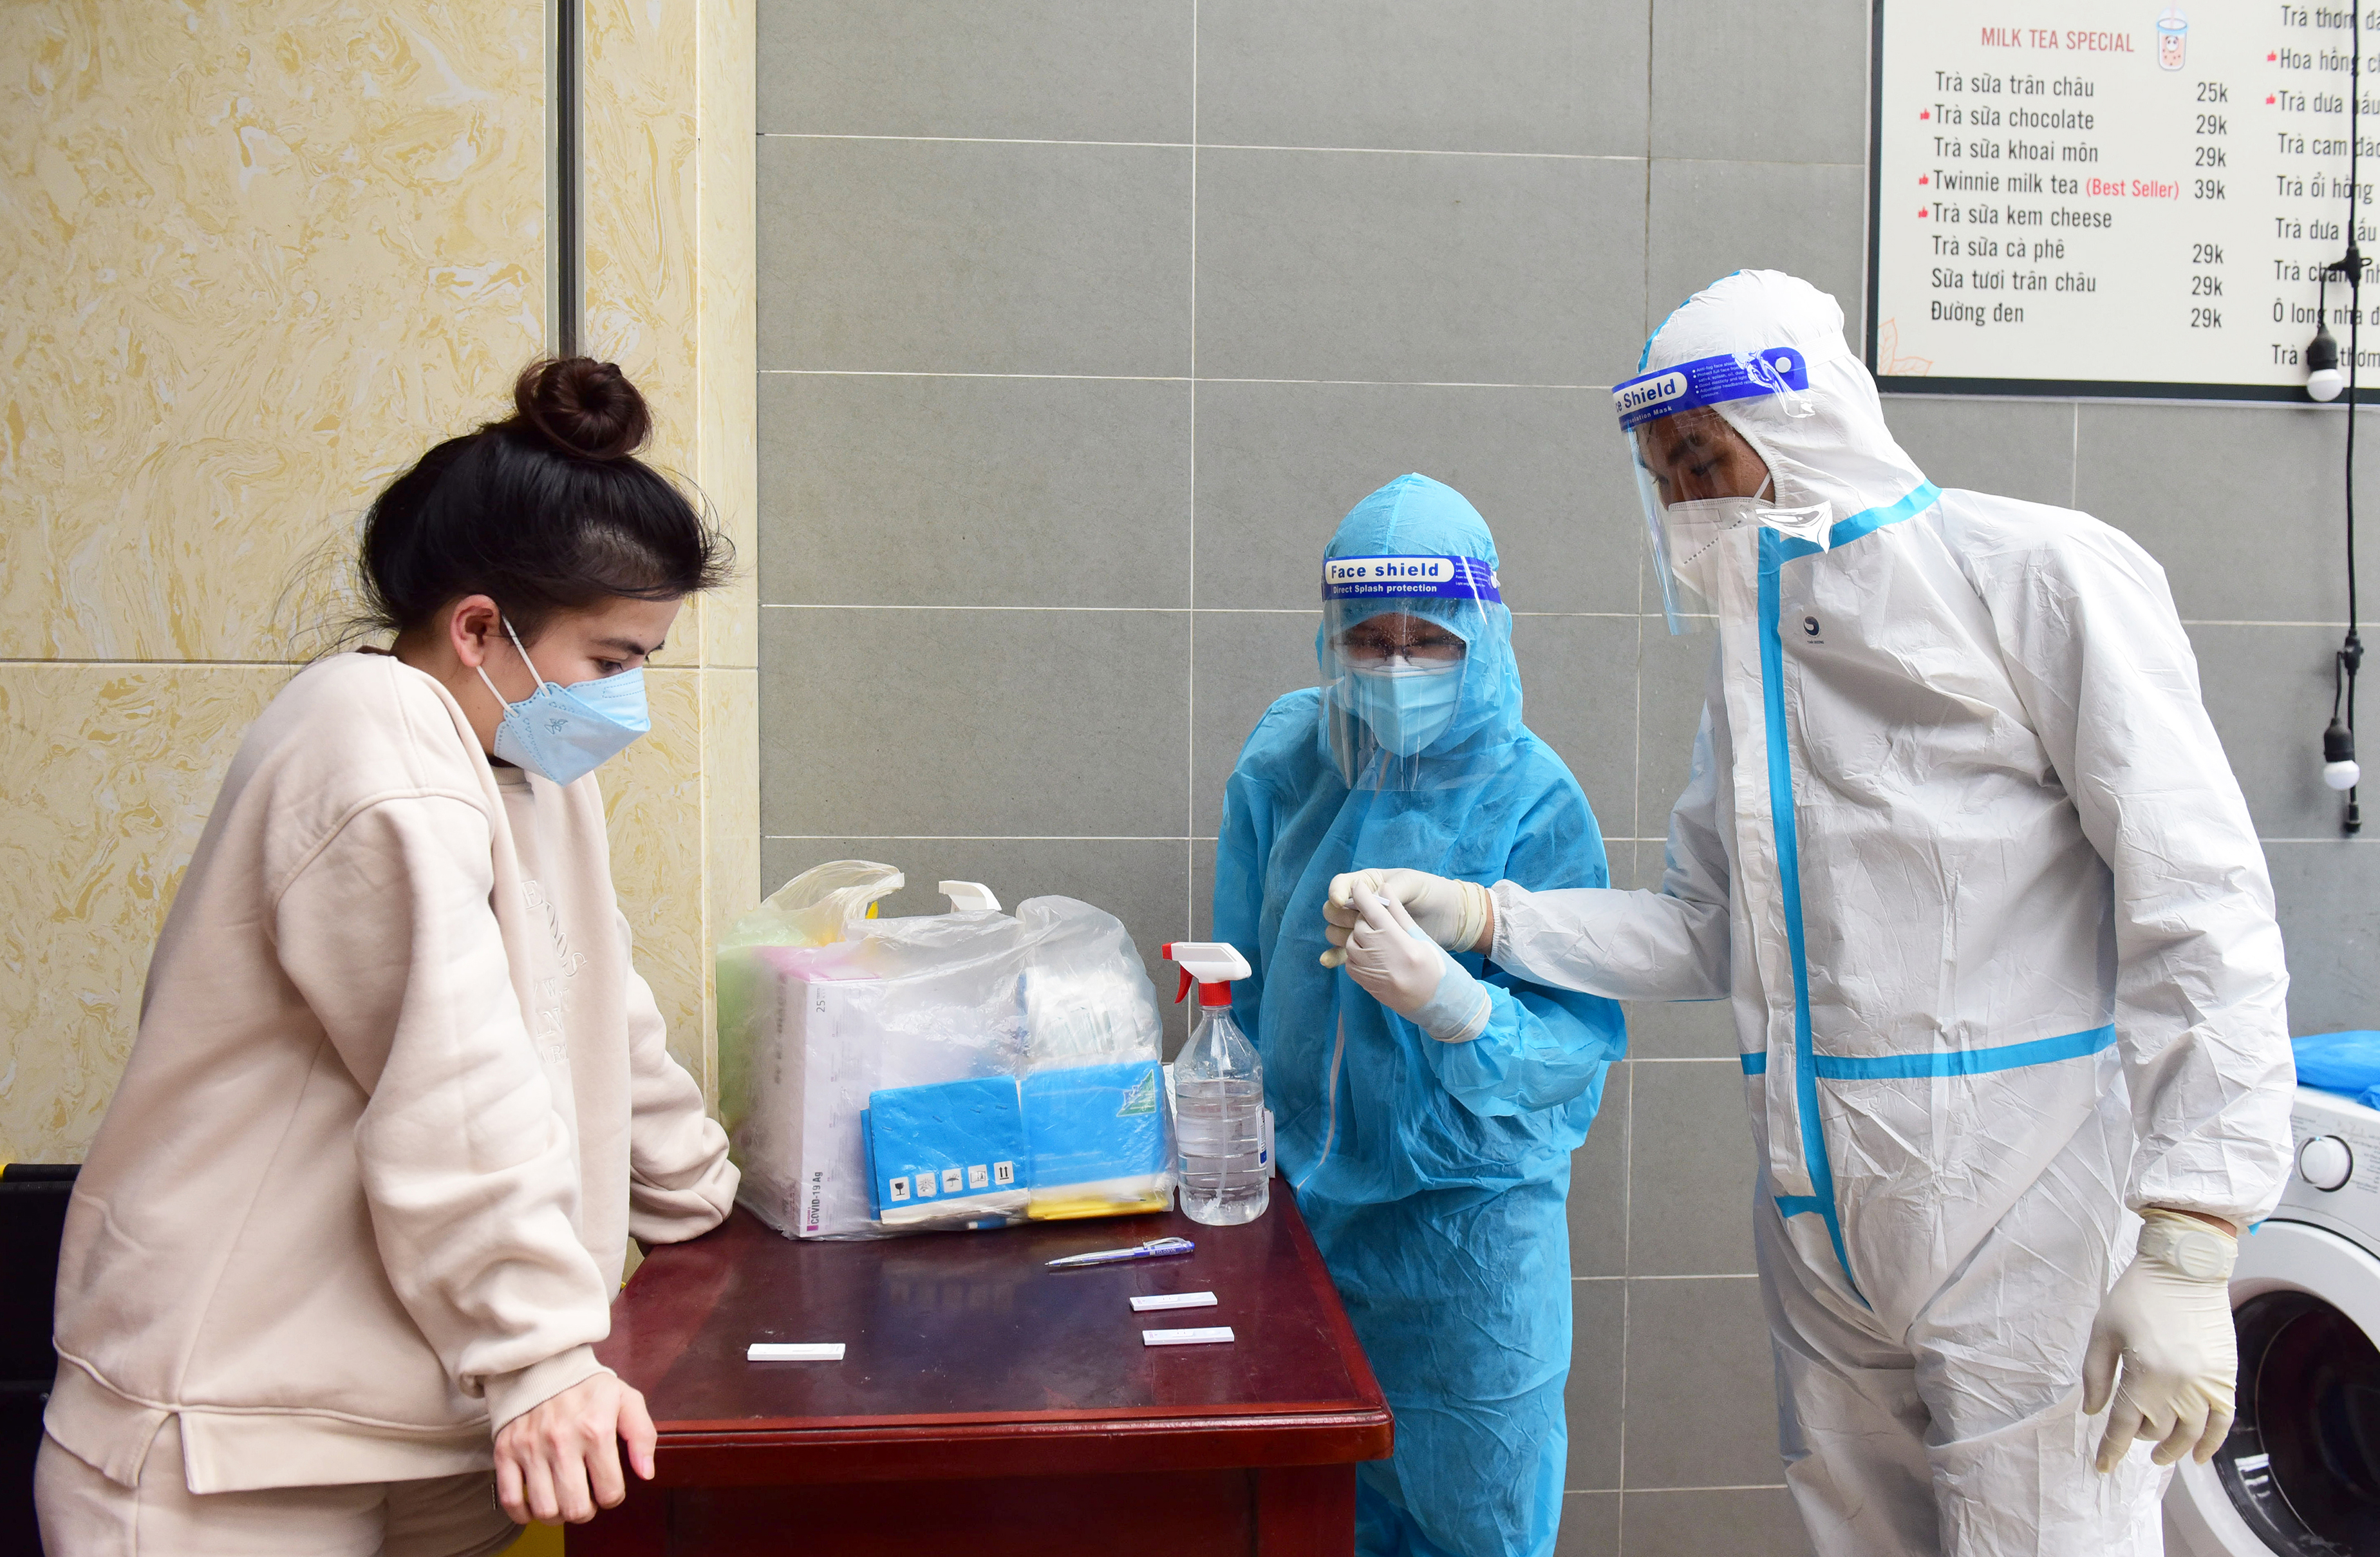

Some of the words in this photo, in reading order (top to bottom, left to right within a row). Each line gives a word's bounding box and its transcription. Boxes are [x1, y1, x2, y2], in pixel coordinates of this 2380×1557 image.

[2282, 5, 2308, 26] Trà
[1982, 27, 2021, 47] MILK
[2029, 29, 2059, 49] TEA
[2066, 31, 2134, 52] SPECIAL
[2280, 48, 2312, 70] Hoa
[1935, 70, 1963, 92] Trà
[1971, 73, 2001, 93] sữa
[2009, 74, 2045, 95] trân
[2053, 76, 2094, 97] châu
[2197, 81, 2228, 102] 25k
[2279, 90, 2305, 111] Trà
[2314, 92, 2343, 113] dưa
[2352, 91, 2380, 115] ấu
[1935, 103, 1962, 125] Trà
[1971, 105, 2000, 126] sữa
[2009, 107, 2094, 130] chocolate
[2196, 113, 2227, 135] 29k
[1934, 136, 1962, 158] Trà
[1970, 138, 2000, 159] sữa
[2009, 139, 2054, 161] khoai
[2063, 142, 2098, 162] môn
[2278, 132, 2304, 154] Trà
[2312, 139, 2348, 156] cam
[2195, 146, 2226, 167] 29k
[1933, 169, 2000, 192] Twinnie
[2007, 173, 2043, 193] milk
[2050, 175, 2078, 194] tea
[2086, 178, 2126, 197] (Best
[2132, 179, 2179, 200] Seller)
[2194, 178, 2225, 200] 39k
[2277, 175, 2303, 196] Trà
[2311, 171, 2325, 198] ổi
[1933, 202, 1960, 223] Trà
[1969, 203, 1999, 225] sữa
[2007, 205, 2043, 226] kem
[2050, 206, 2112, 228] cheese
[2275, 217, 2301, 238] Trà
[2310, 219, 2339, 240] dưa
[2349, 217, 2377, 241] ấu
[1932, 235, 1960, 256] Trà
[1968, 236, 1998, 257] sữa
[2006, 238, 2026, 258] cà
[2034, 238, 2065, 263] phê
[2193, 243, 2224, 264] 29k
[1931, 267, 1963, 288] Sữa
[1972, 269, 2004, 290] tươi
[2012, 270, 2048, 290] trân
[2055, 272, 2096, 292] châu
[2274, 260, 2300, 281] Trà
[2191, 275, 2223, 296] 29k
[1931, 300, 1986, 327] Đường
[1993, 302, 2024, 323] đen
[2191, 307, 2222, 328] 29k
[2273, 297, 2283, 323] Ô
[2272, 344, 2298, 364] Trà
[1624, 379, 1676, 408] Shield
[1653, 406, 1673, 415] Mask
[1331, 565, 1367, 580] Face
[1375, 562, 1439, 577] shield
[1333, 585, 1353, 594] Direct
[1354, 583, 1384, 595] Splash
[1387, 584, 1438, 594] protection
[816, 1001, 825, 1013] 25
[812, 1172, 823, 1183] Ag
[811, 1185, 821, 1225] COVID-19
